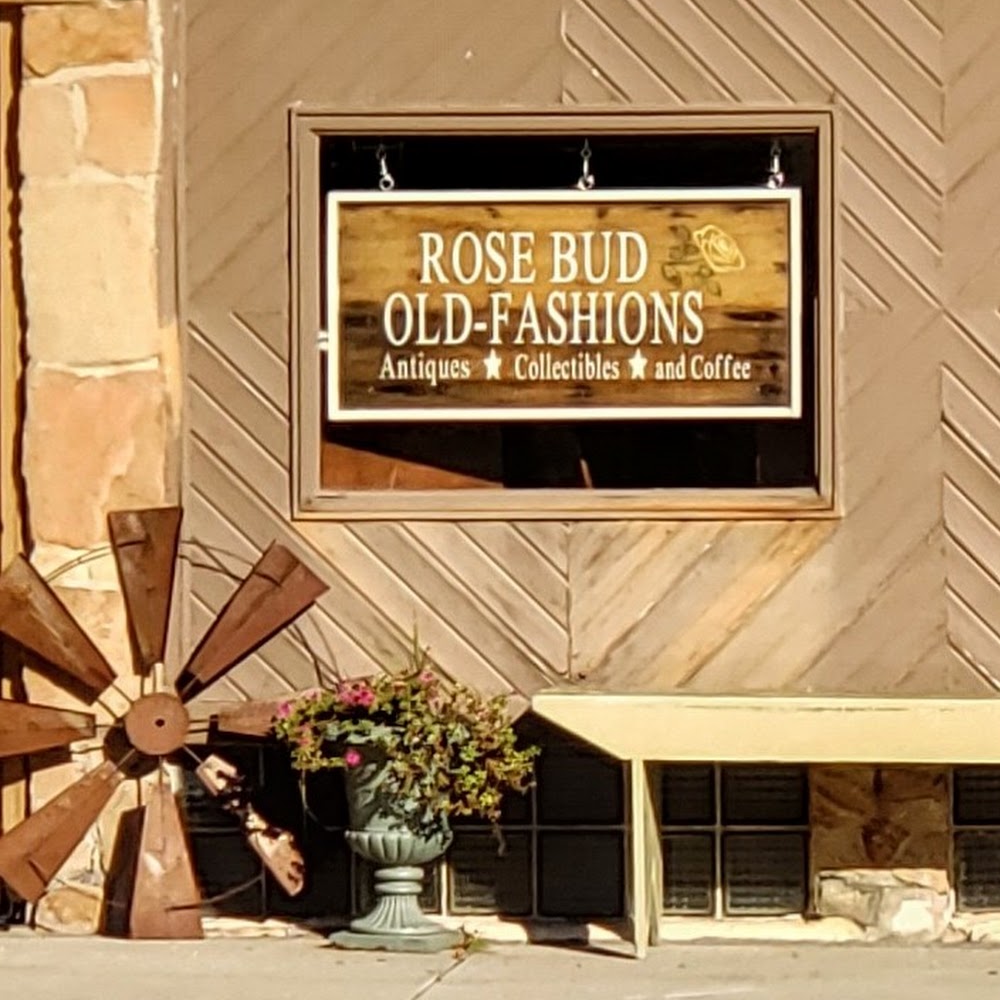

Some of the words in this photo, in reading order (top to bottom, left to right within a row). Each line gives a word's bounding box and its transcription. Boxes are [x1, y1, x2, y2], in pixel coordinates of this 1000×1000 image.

[419, 231, 537, 285] ROSE
[550, 230, 649, 284] BUD
[383, 290, 704, 346] OLD-FASHIONS
[379, 351, 471, 386] Antiques
[514, 353, 620, 381] Collectibles
[655, 354, 686, 381] and
[690, 353, 752, 381] Coffee
